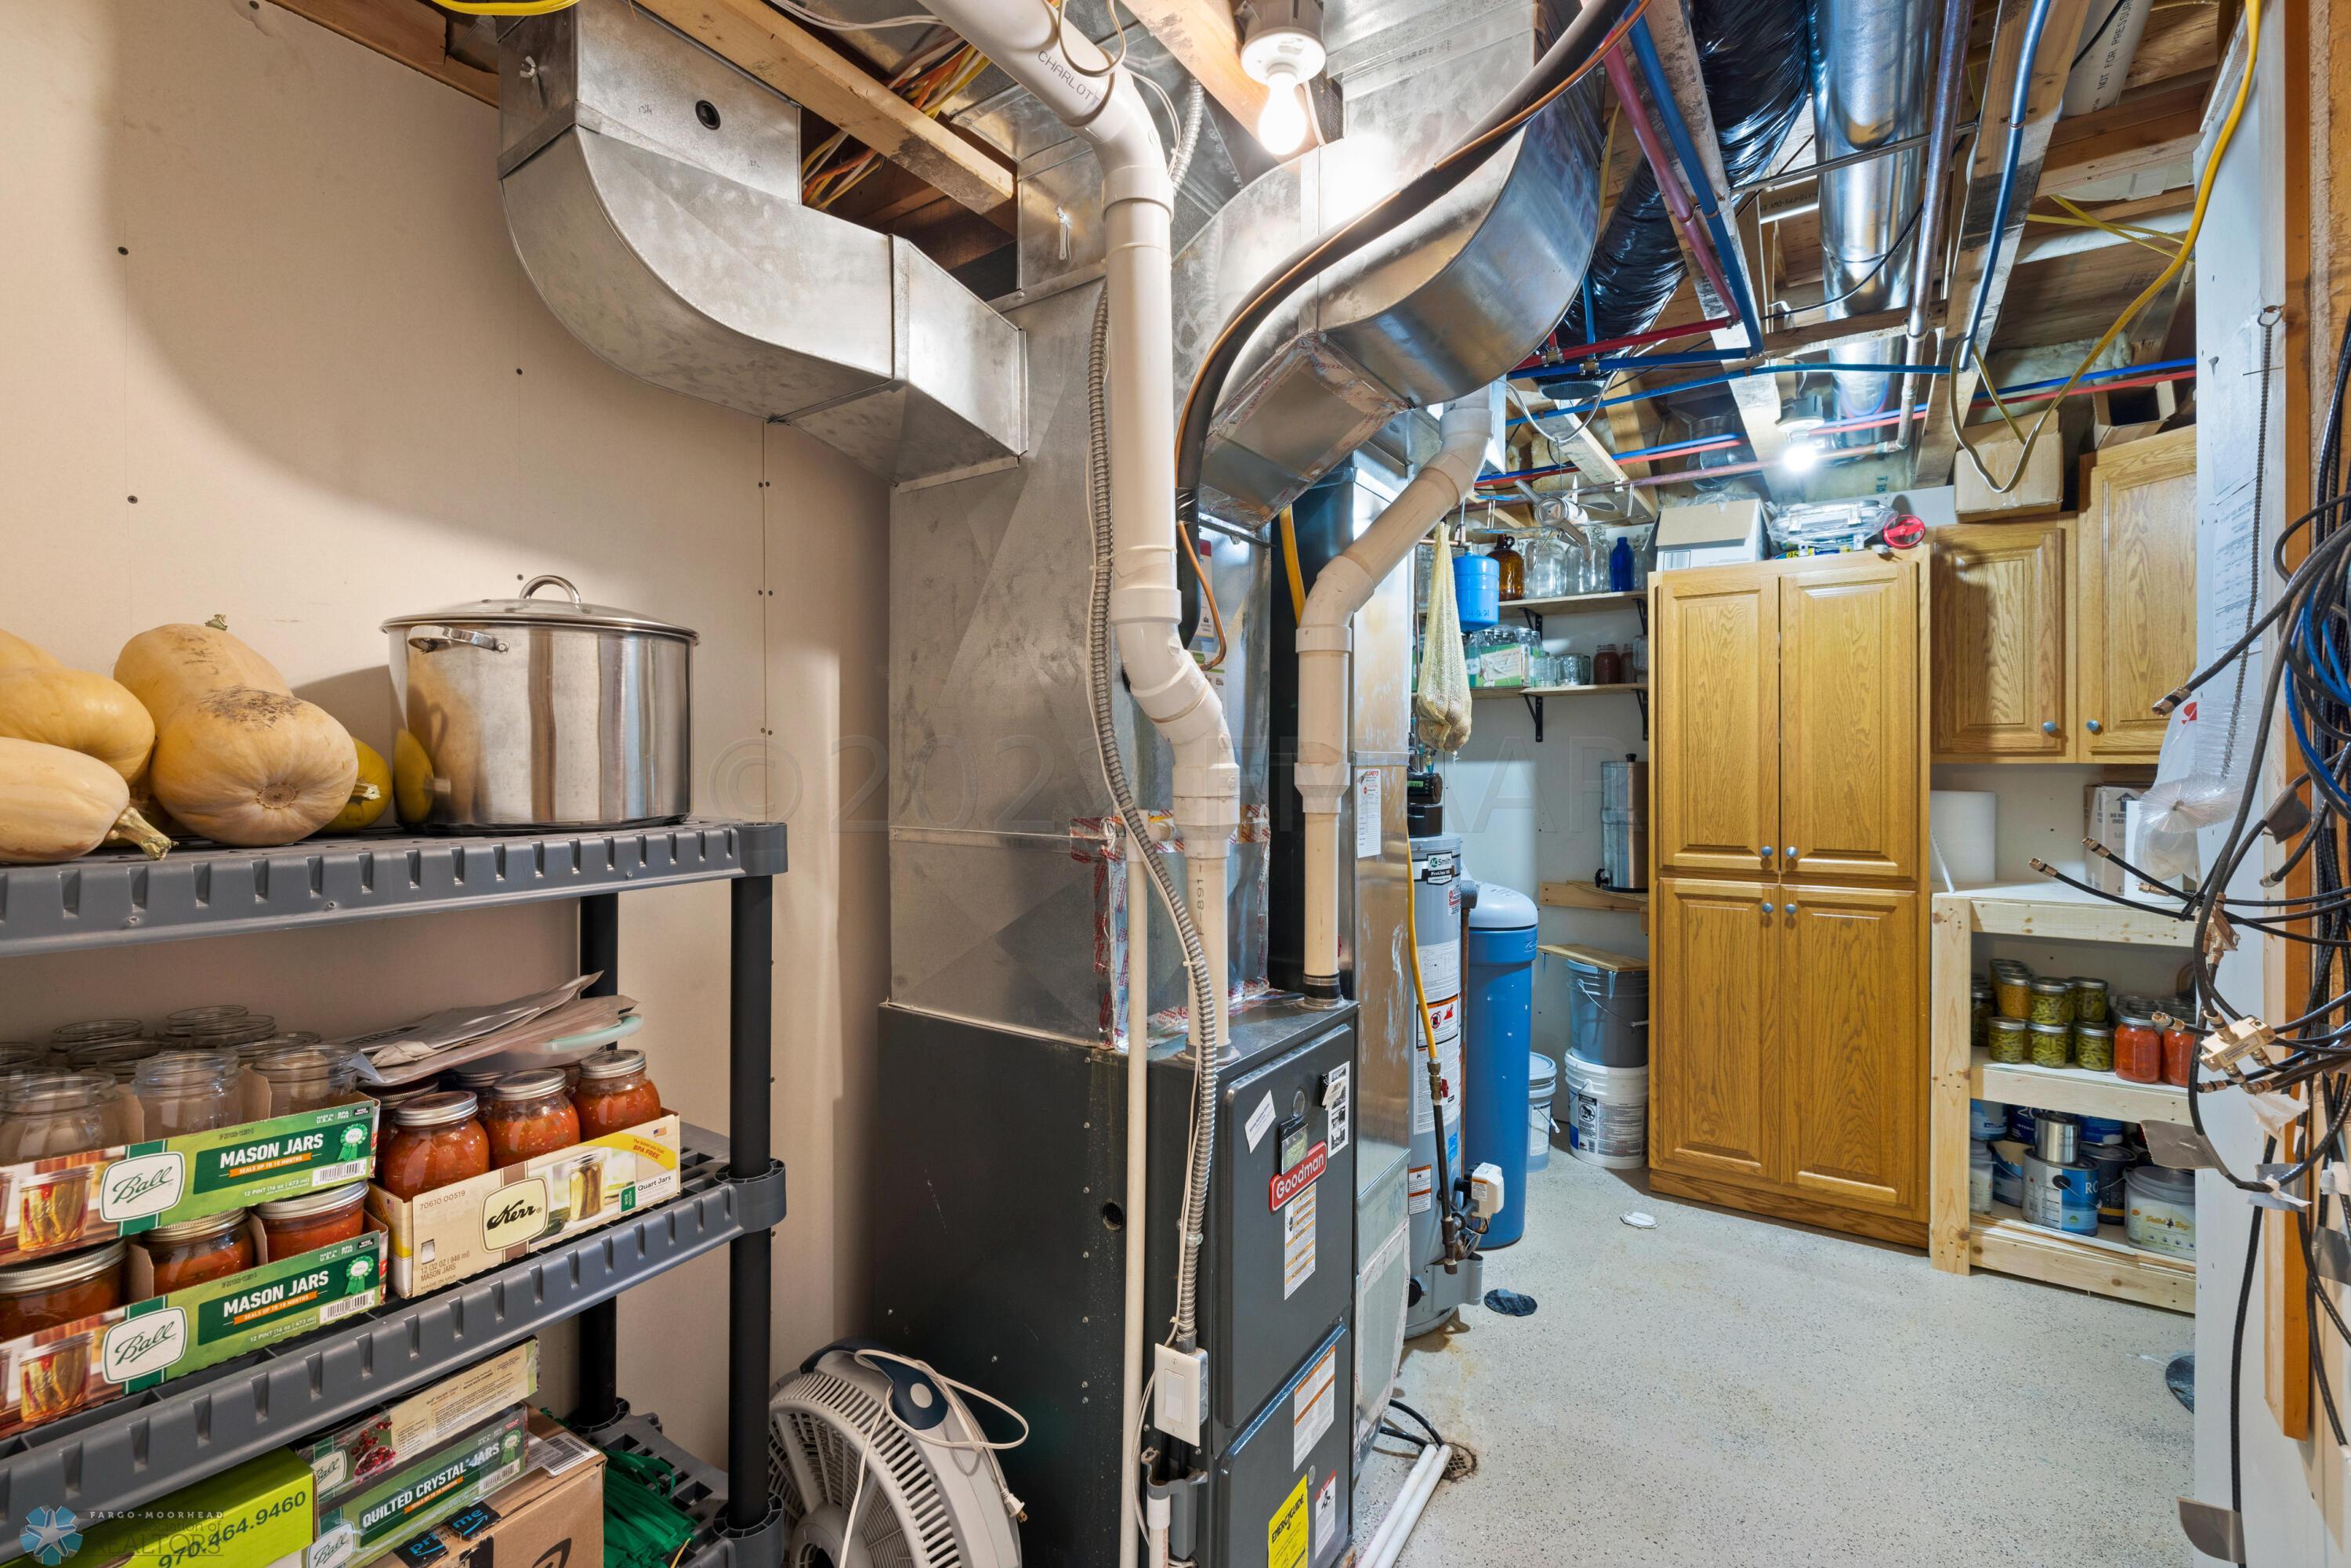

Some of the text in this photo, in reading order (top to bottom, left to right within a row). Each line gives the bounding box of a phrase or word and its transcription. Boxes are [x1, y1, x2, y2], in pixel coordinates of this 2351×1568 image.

[220, 1143, 279, 1168] MASON
[283, 1133, 324, 1156] JARS
[633, 1145, 660, 1160] BPA FREE
[239, 1164, 256, 1174] SEALS
[281, 1156, 302, 1166] MONTHS
[1276, 1153, 1324, 1200] Goodman
[111, 1166, 174, 1204] Ball
[252, 1187, 266, 1196] PINT
[638, 1175, 672, 1192] Quart Jars
[419, 1190, 465, 1211] 70610 00519
[487, 1199, 536, 1230] Kerr
[421, 1266, 428, 1275] 12
[451, 1255, 460, 1263] 946
[461, 1250, 470, 1260] ml)
[421, 1263, 456, 1281] MASON JARS
[223, 1287, 284, 1317] MASON
[288, 1270, 328, 1296] JARS
[421, 1282, 437, 1291] MADE
[245, 1310, 262, 1320] SEALS
[287, 1295, 309, 1306] MONTHS
[114, 1321, 177, 1366] Ball
[258, 1331, 273, 1340] PINT
[469, 1443, 499, 1467] JARS
[362, 1465, 468, 1528] QUILTED CRYSTAL
[158, 1490, 306, 1567] 970.464.9460
[313, 1533, 350, 1567] Ball
